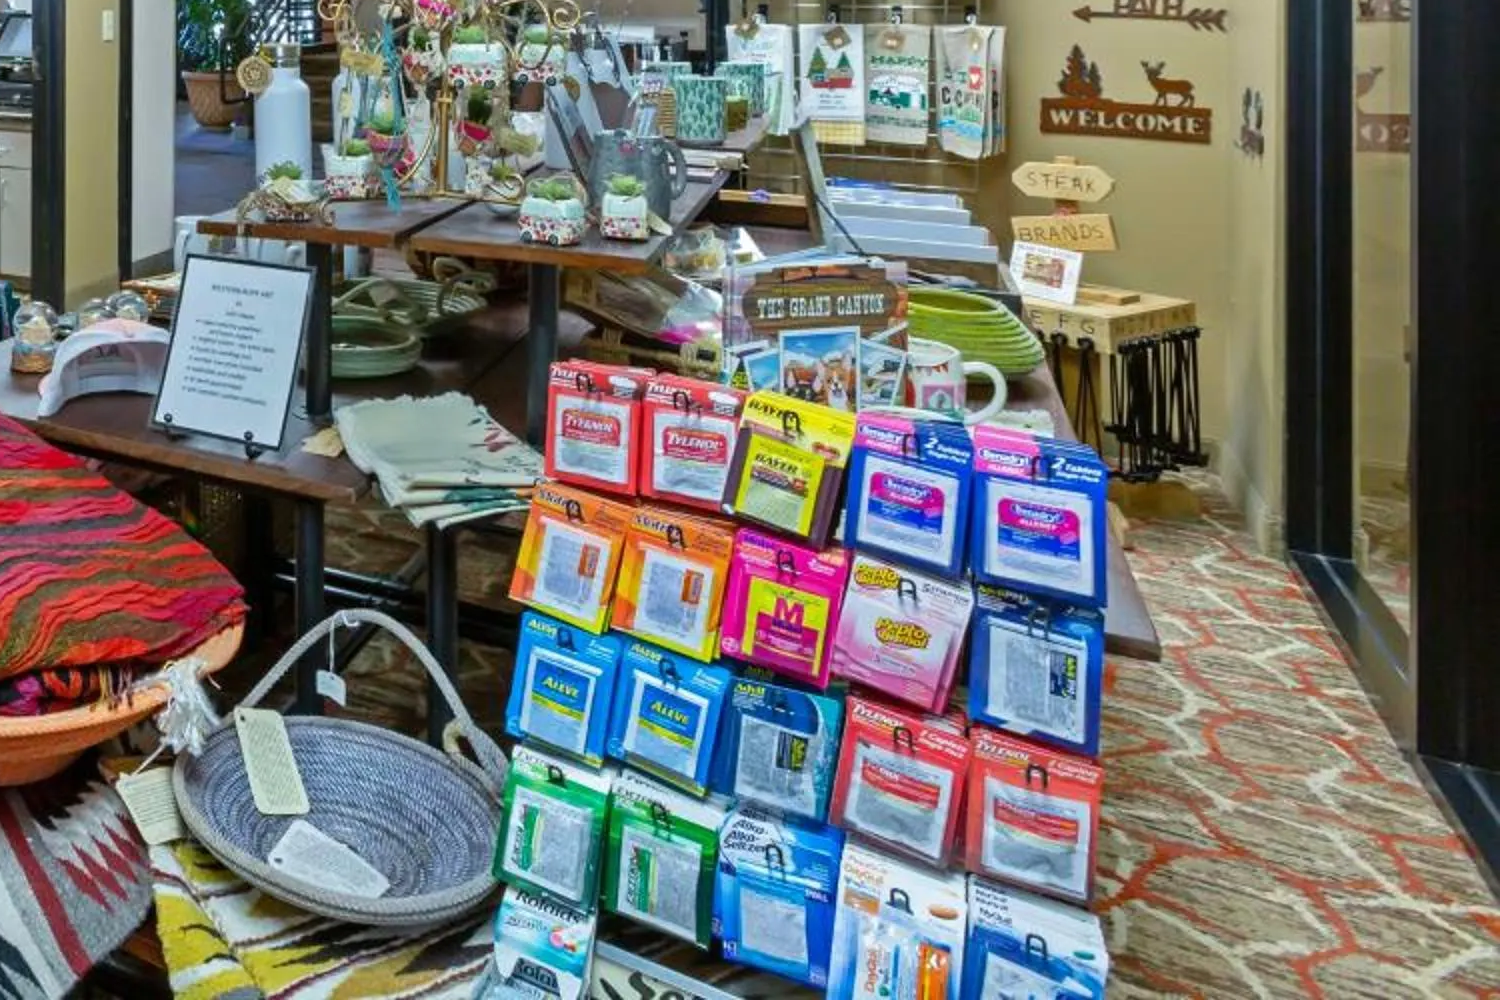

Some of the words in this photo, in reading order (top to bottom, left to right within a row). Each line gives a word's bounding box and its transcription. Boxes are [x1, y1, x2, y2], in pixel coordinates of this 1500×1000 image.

[1049, 107, 1205, 135] WELCOME
[1026, 170, 1097, 193] STEAK
[1017, 221, 1105, 242] BRANDS
[789, 295, 832, 318] GRAND
[835, 292, 886, 316] CANYON
[1080, 318, 1095, 335] G
[550, 365, 594, 387] TYLE
[666, 429, 722, 451] TYLENOL
[924, 437, 938, 449] 2
[1051, 457, 1066, 470] 2
[542, 676, 579, 698] ALEVE
[651, 700, 689, 724] ALEVE
